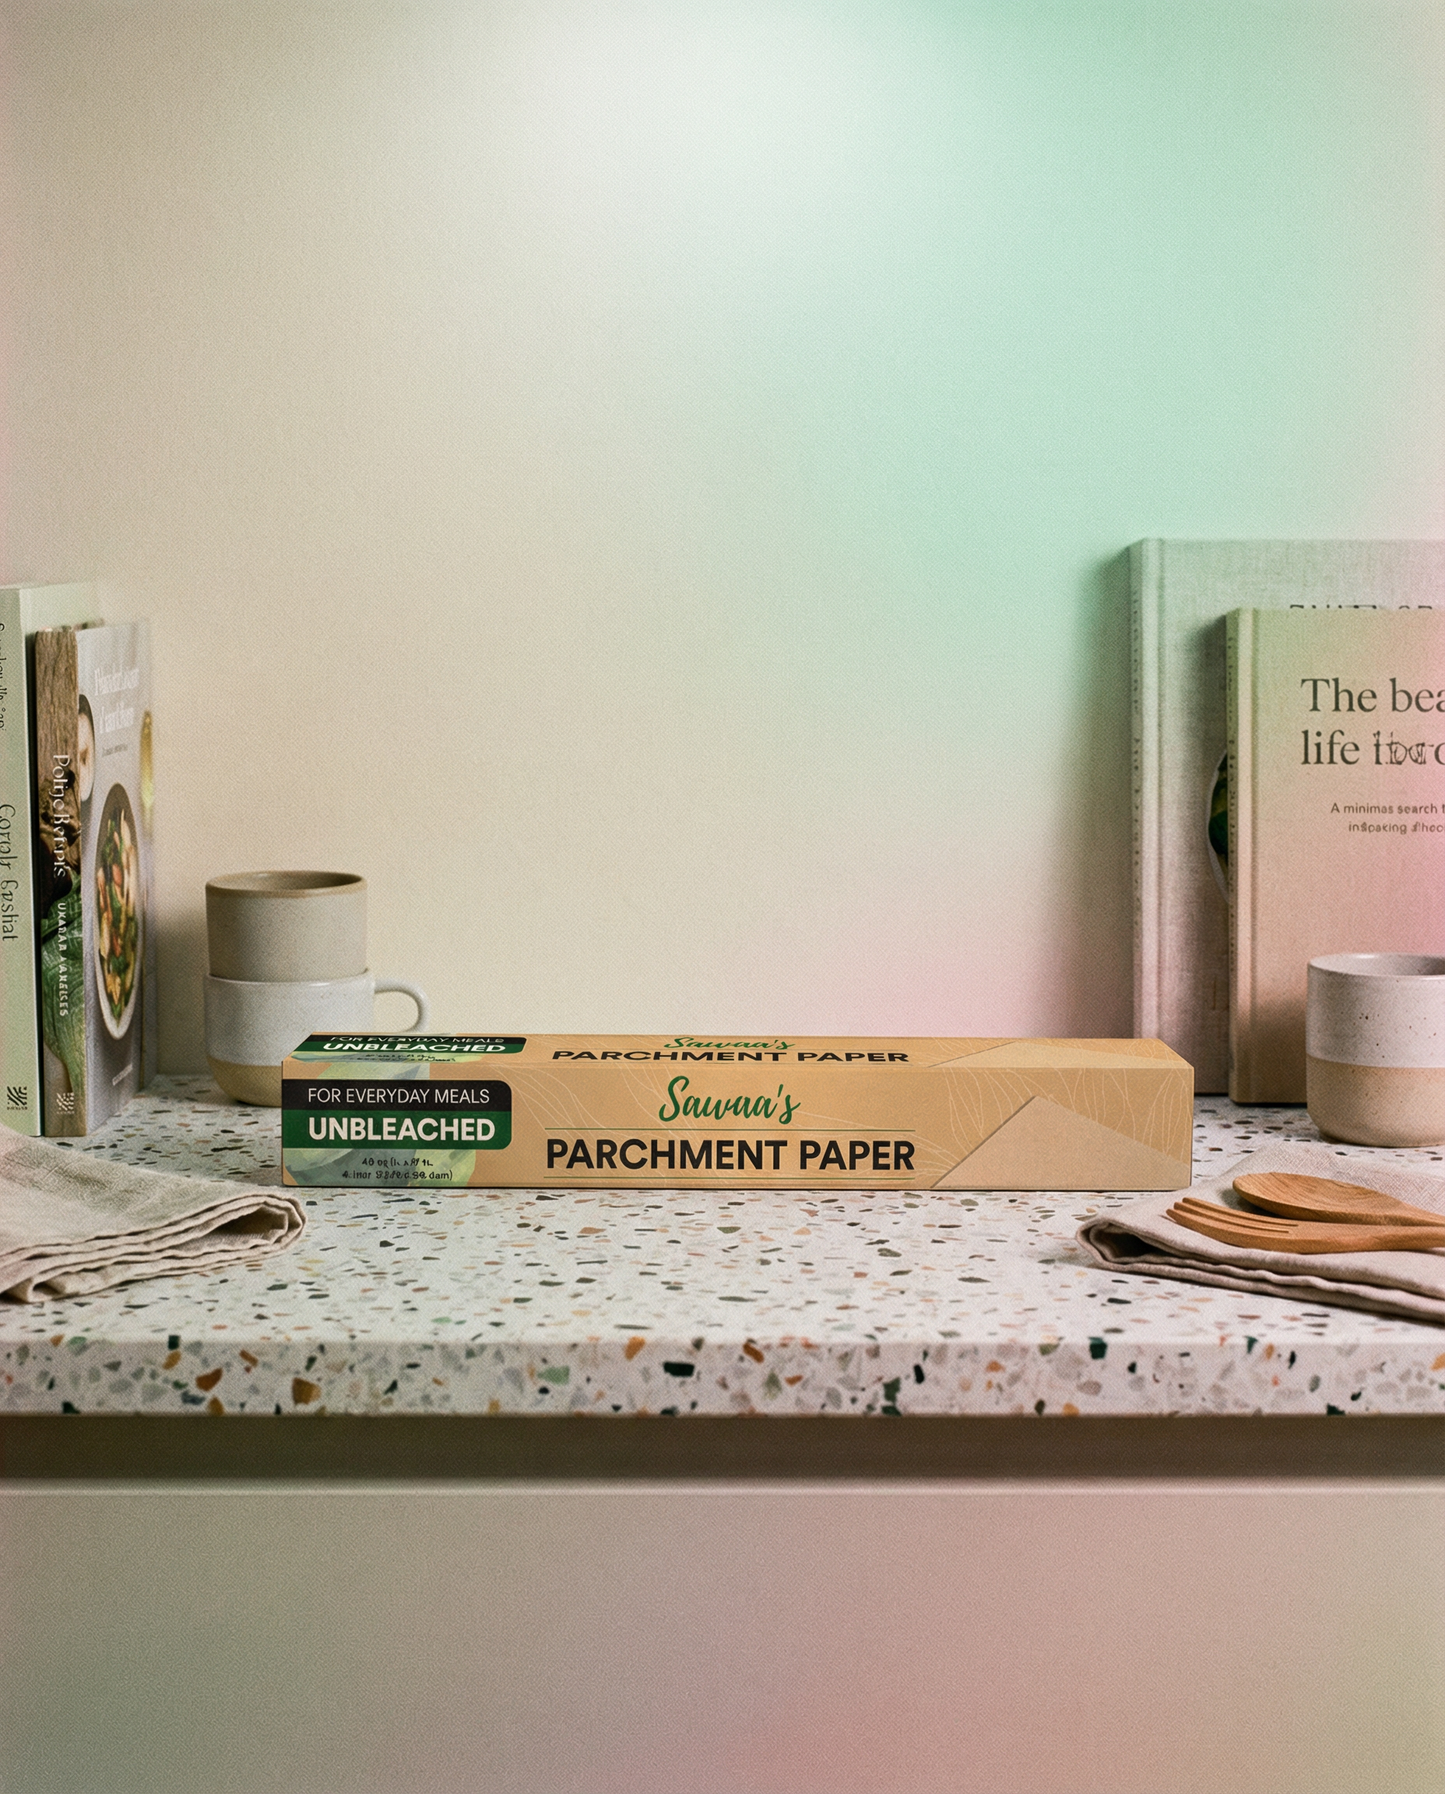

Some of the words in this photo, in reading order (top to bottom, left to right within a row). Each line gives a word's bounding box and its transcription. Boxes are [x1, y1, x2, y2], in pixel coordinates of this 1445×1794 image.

[1300, 677, 1377, 712] The
[1301, 729, 1360, 765] life
[1330, 802, 1340, 814] A
[323, 1043, 506, 1052] UNBLEACHED
[552, 1051, 787, 1061] PARCHMENT
[797, 1052, 909, 1062] PAPER
[308, 1088, 341, 1103] FOR
[346, 1088, 430, 1103] EVERYDAY
[434, 1089, 490, 1104] MEALS
[658, 1075, 801, 1125] Sawaa's
[308, 1117, 496, 1141] UNBLEACHED
[546, 1139, 788, 1170] PARCHMENT
[800, 1140, 915, 1170] PAPER
